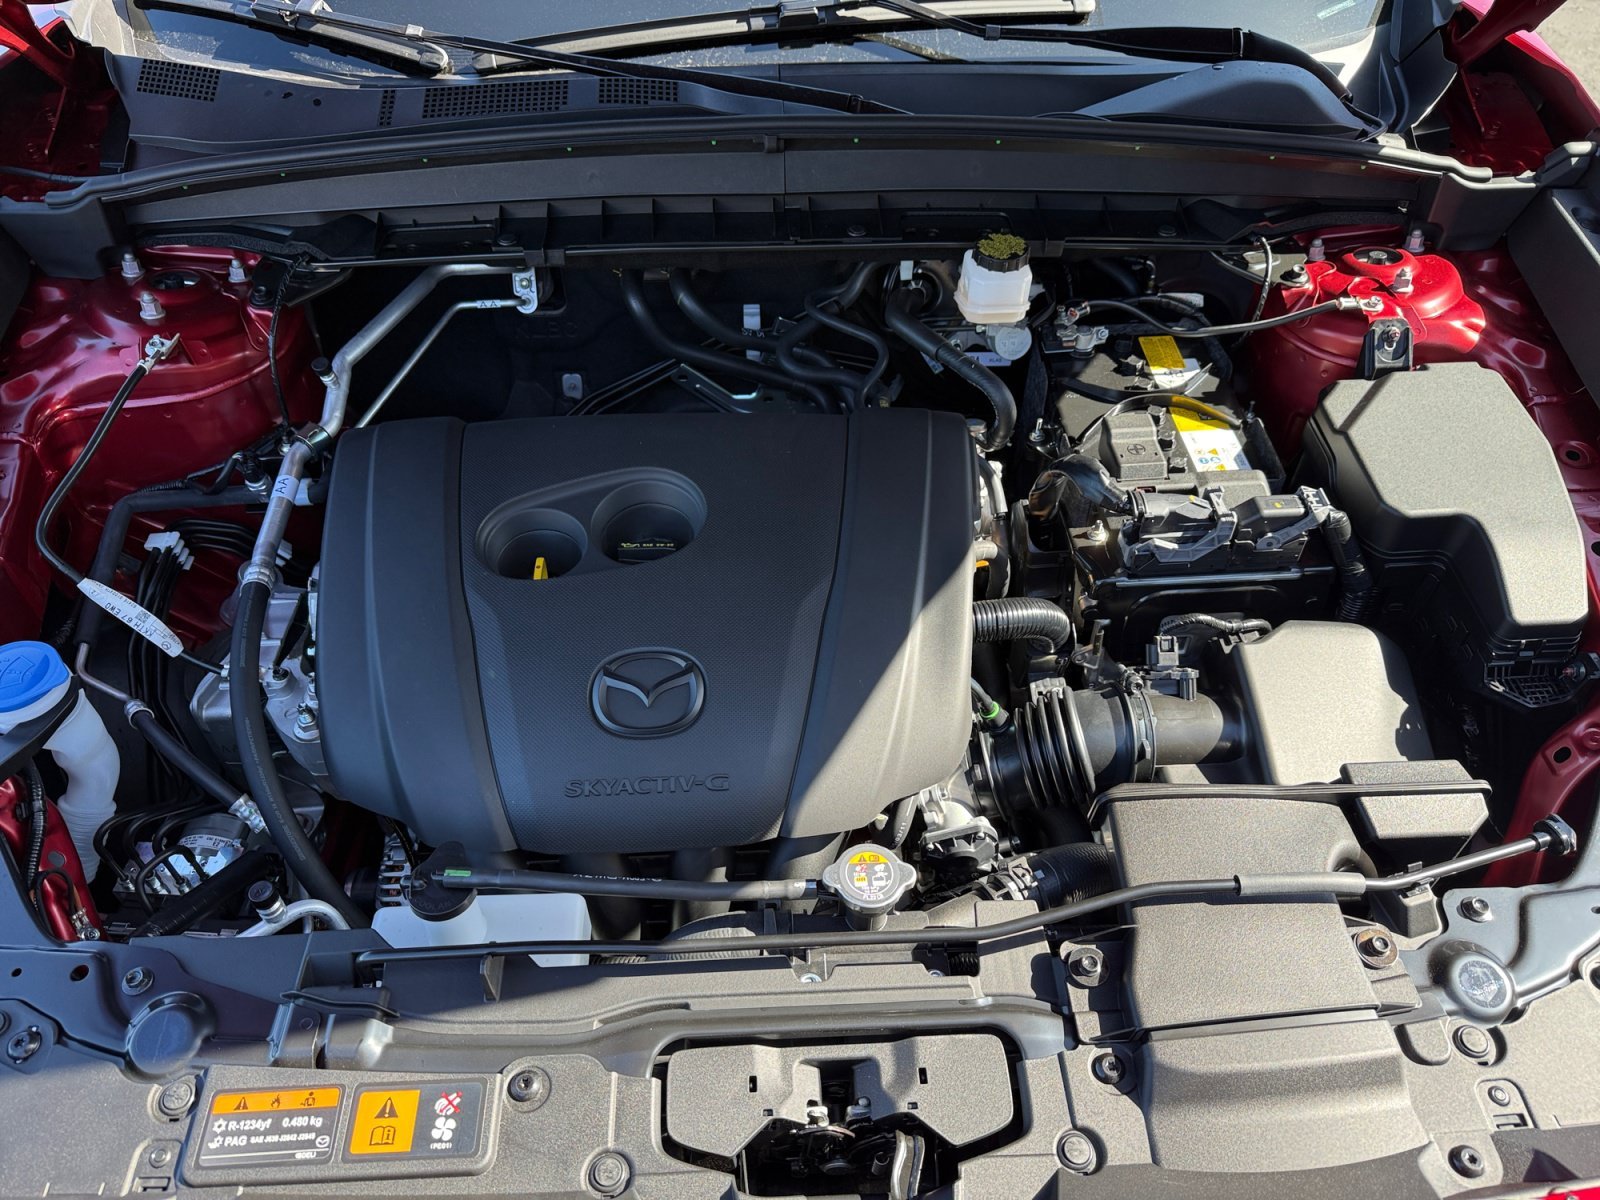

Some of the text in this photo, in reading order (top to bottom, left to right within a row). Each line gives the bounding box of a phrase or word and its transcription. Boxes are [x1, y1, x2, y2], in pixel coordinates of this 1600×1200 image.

[274, 477, 289, 494] AA
[564, 773, 729, 798] SKYACTIV-G
[227, 1118, 272, 1131] R-1234yf
[309, 1115, 323, 1127] kg
[224, 1135, 248, 1147] PAG
